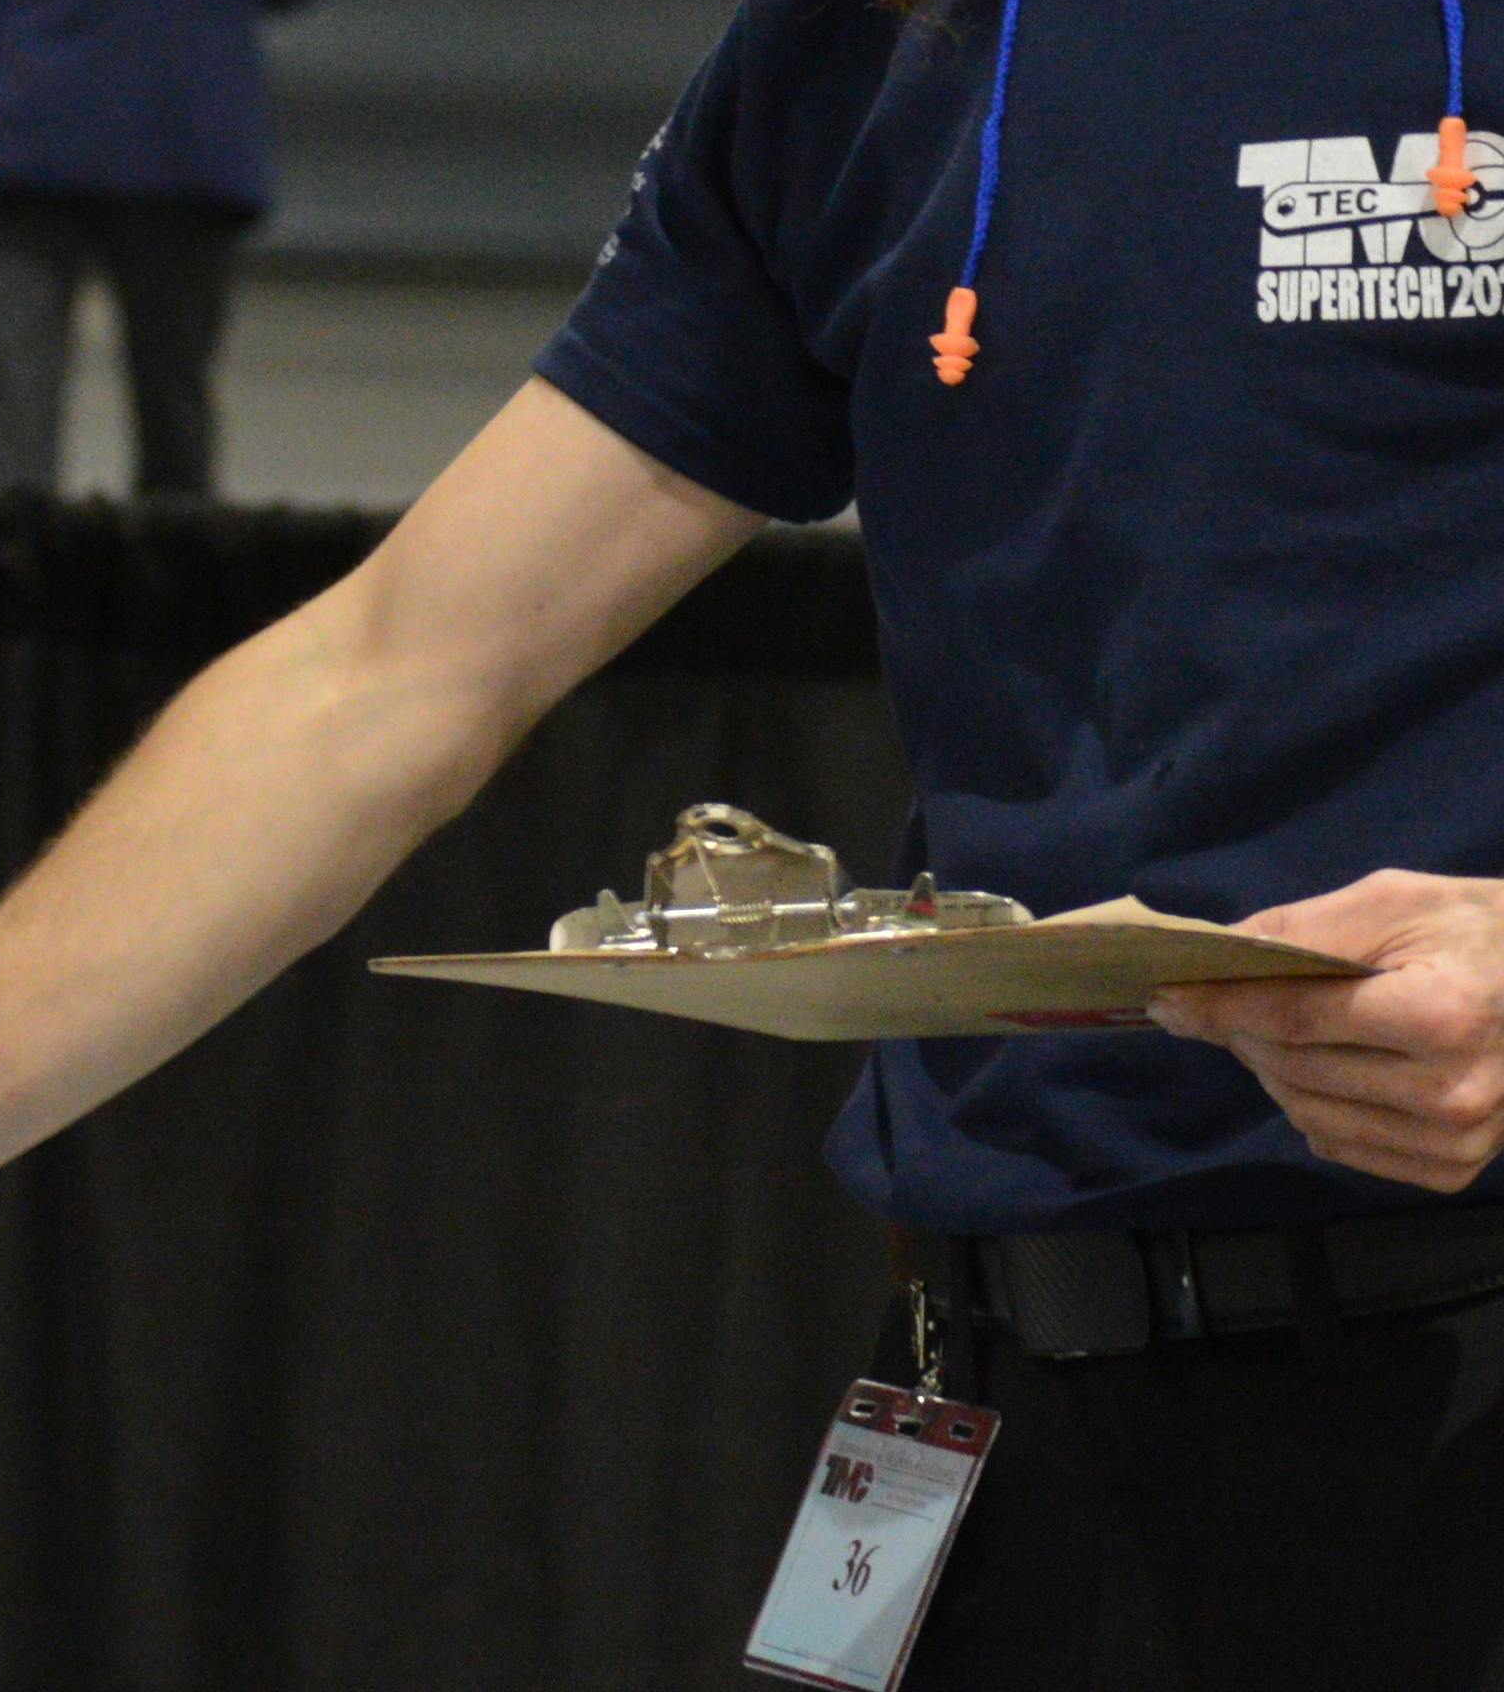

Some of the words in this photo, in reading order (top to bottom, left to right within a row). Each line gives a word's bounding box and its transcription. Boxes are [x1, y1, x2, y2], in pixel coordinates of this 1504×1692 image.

[1308, 188, 1380, 217] TEC
[1257, 265, 1445, 323] SUPERTECH
[831, 1539, 882, 1597] 36
